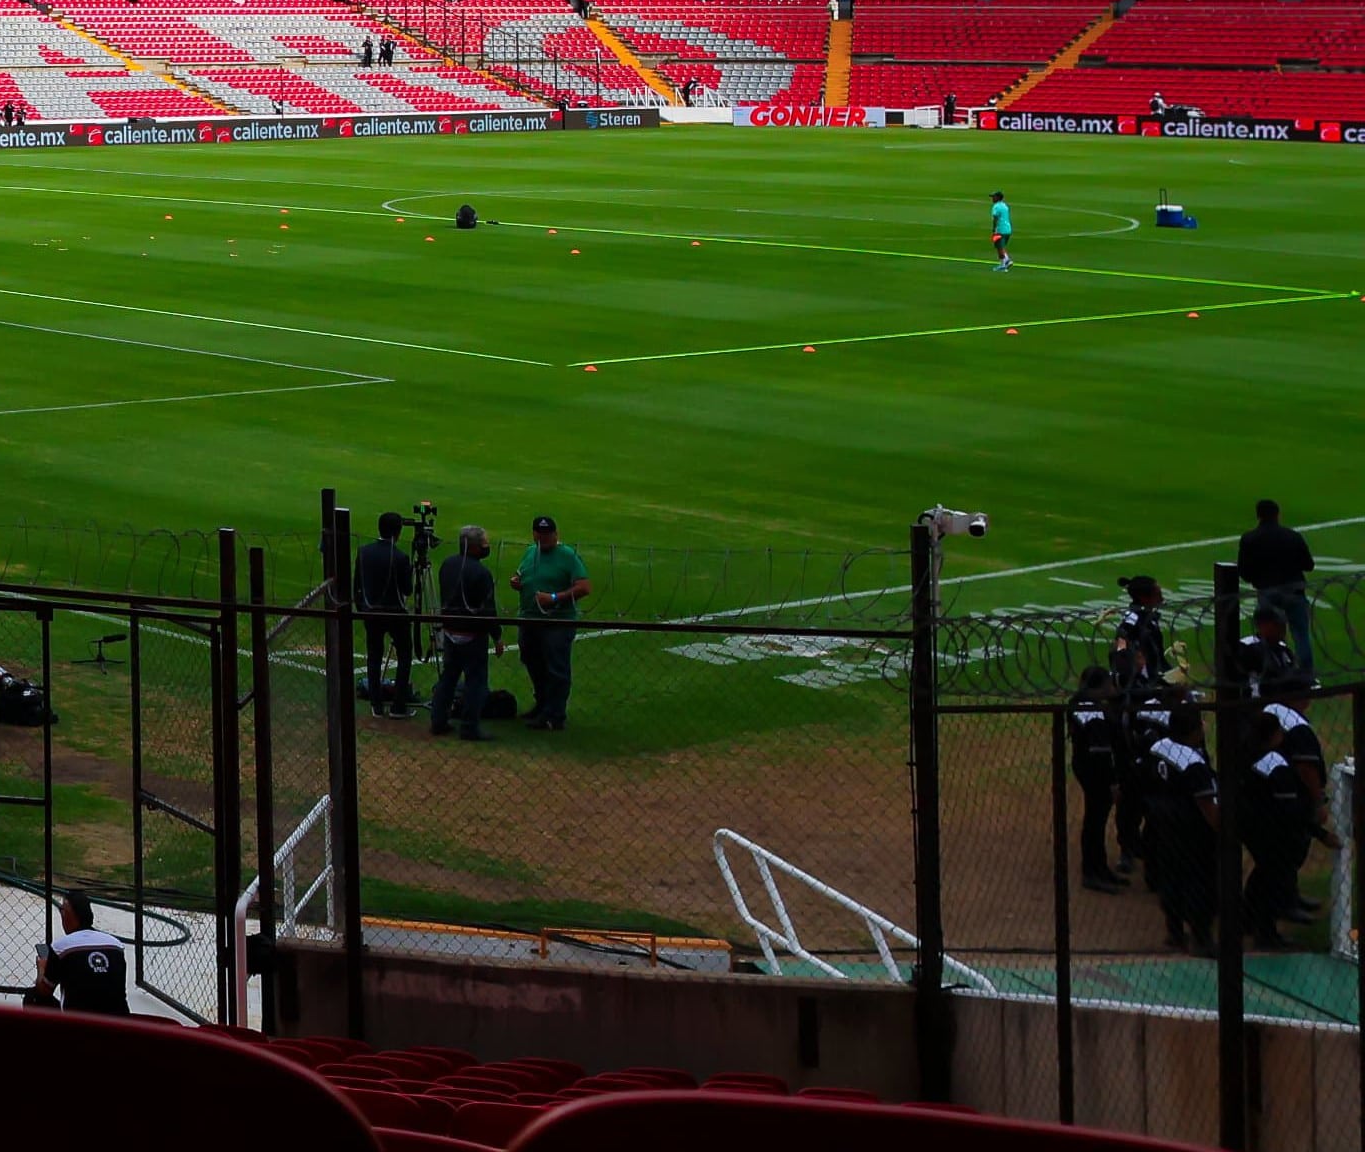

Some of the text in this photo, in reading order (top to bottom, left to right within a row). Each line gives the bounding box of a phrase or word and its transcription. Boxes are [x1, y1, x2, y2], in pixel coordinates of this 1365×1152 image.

[354, 119, 435, 136] caliente.mx
[470, 114, 546, 132] caliente.mx
[600, 112, 641, 127] Steren
[1000, 115, 1113, 133] caliente.mx
[105, 124, 195, 144] caliente.mx
[233, 121, 318, 140] caliente.mx
[1164, 120, 1289, 140] caliente.mx
